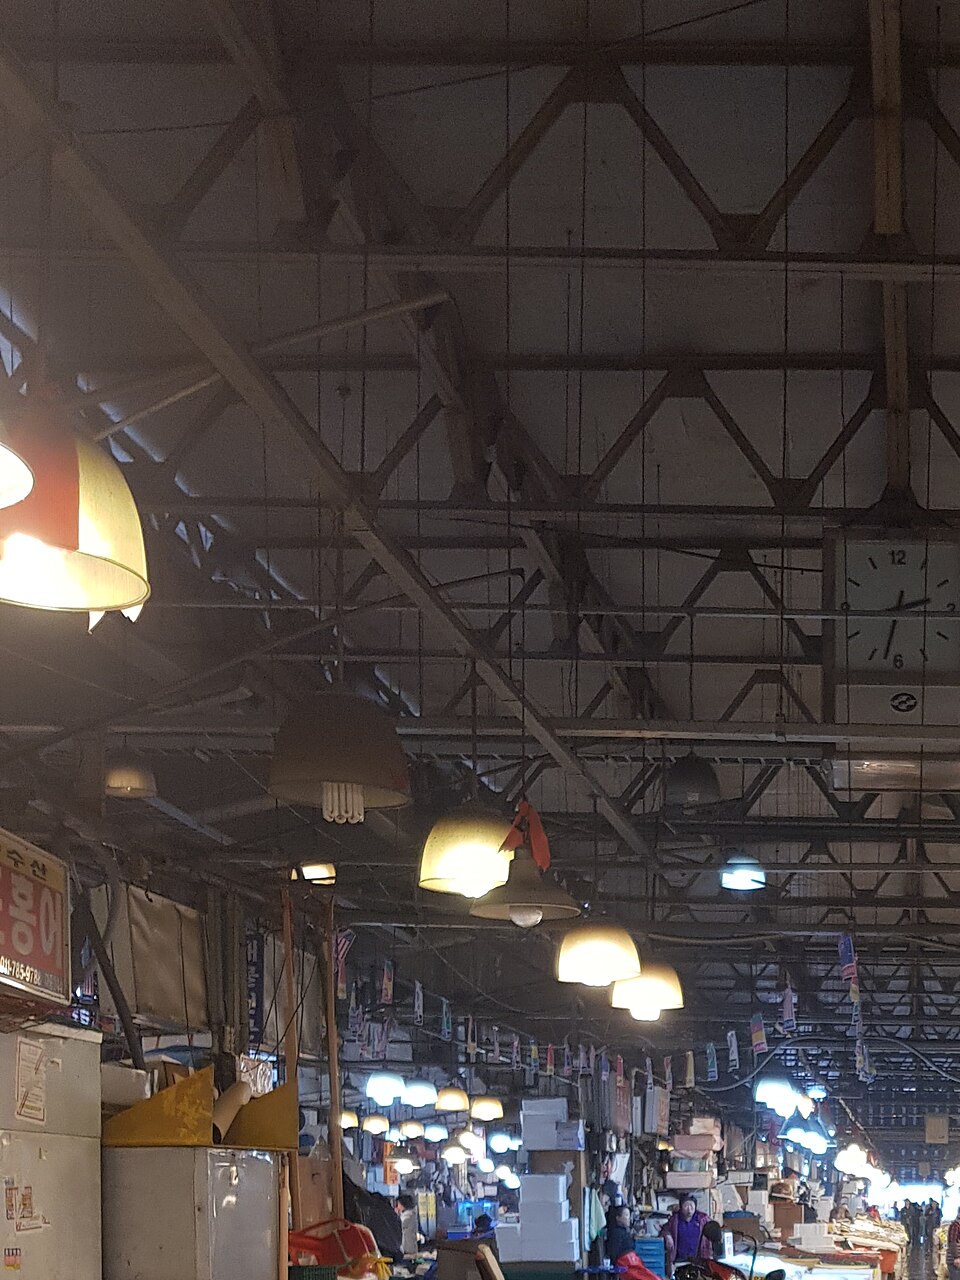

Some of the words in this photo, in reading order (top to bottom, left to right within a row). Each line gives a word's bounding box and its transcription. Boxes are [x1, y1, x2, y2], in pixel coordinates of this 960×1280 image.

[889, 549, 907, 566] 12
[893, 654, 904, 670] 6
[0, 872, 63, 969] 홍어
